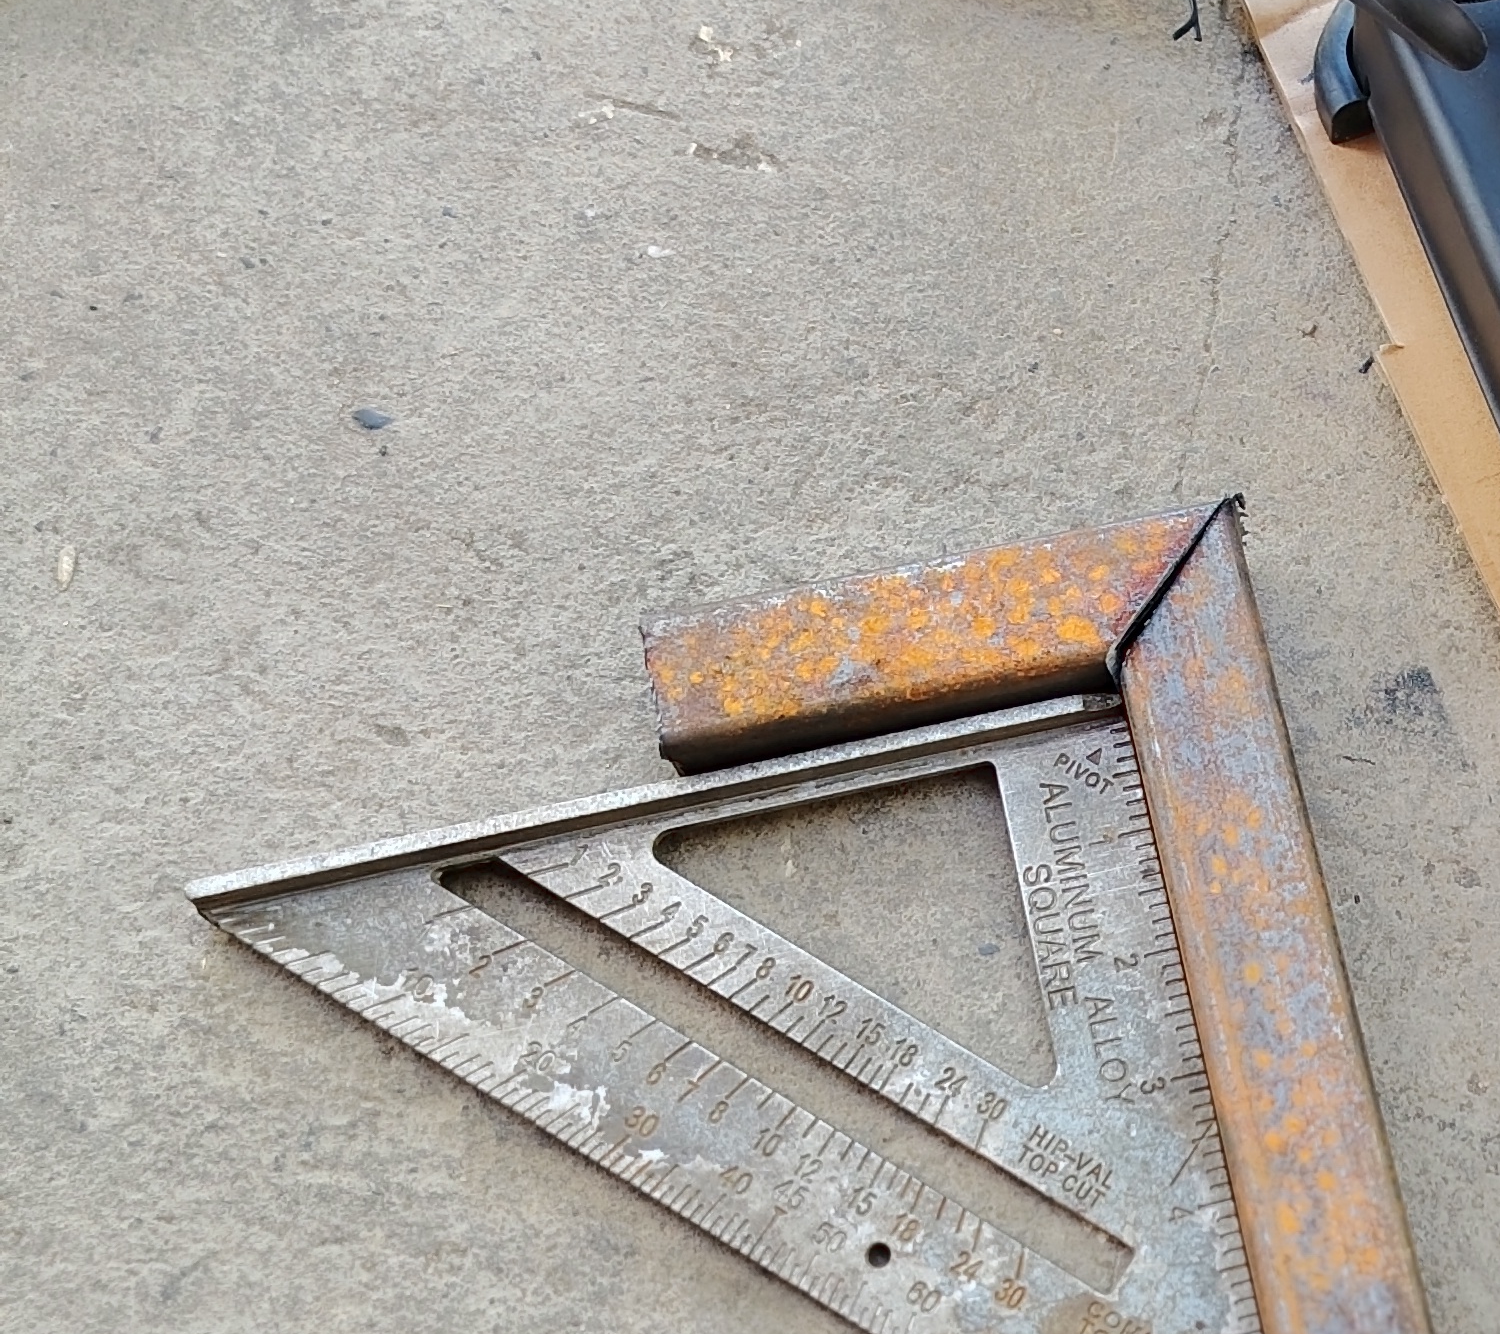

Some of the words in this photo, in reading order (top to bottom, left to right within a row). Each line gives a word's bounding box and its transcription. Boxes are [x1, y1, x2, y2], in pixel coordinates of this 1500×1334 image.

[1053, 752, 1115, 795] PIVOT
[569, 843, 588, 866] 1
[597, 861, 625, 888] 2
[631, 881, 653, 907] 3
[660, 900, 682, 922] 4
[686, 914, 709, 939] 5
[713, 931, 735, 955] 6
[734, 942, 759, 966] 7
[755, 956, 777, 980] 8
[784, 973, 815, 1004] 10
[817, 993, 849, 1025] 12
[855, 1016, 887, 1046] 15
[890, 1037, 920, 1068] 18
[933, 1065, 969, 1099] 24
[975, 1090, 1009, 1121] 30
[1022, 863, 1079, 1011] SQUARE
[1038, 781, 1104, 964] ALUMINUM
[1083, 995, 1136, 1105] ALLOY
[1088, 833, 1114, 847] 1
[1113, 952, 1139, 973] 2
[1139, 1076, 1166, 1096] 3
[1168, 1205, 1197, 1223] 4
[468, 954, 493, 979] 2
[522, 985, 545, 1010] 3
[611, 1039, 633, 1063] 5
[645, 1061, 668, 1085] 6
[676, 1078, 701, 1104] 7
[707, 1099, 730, 1125] 8
[752, 1127, 783, 1157] 10
[793, 1152, 824, 1184] 12
[846, 1185, 878, 1217] 15
[889, 1212, 921, 1243] 18
[949, 1249, 984, 1283] 24
[994, 1277, 1028, 1311] 30
[519, 1040, 557, 1073] 20
[623, 1104, 661, 1138] 30
[719, 1165, 755, 1195] 40
[772, 1178, 811, 1210] 45
[811, 1221, 848, 1254] 50
[905, 1280, 943, 1314] 60
[1015, 1144, 1060, 1178] TOP
[1060, 1174, 1107, 1208] CUT
[1027, 1123, 1115, 1190] HIP-VAL
